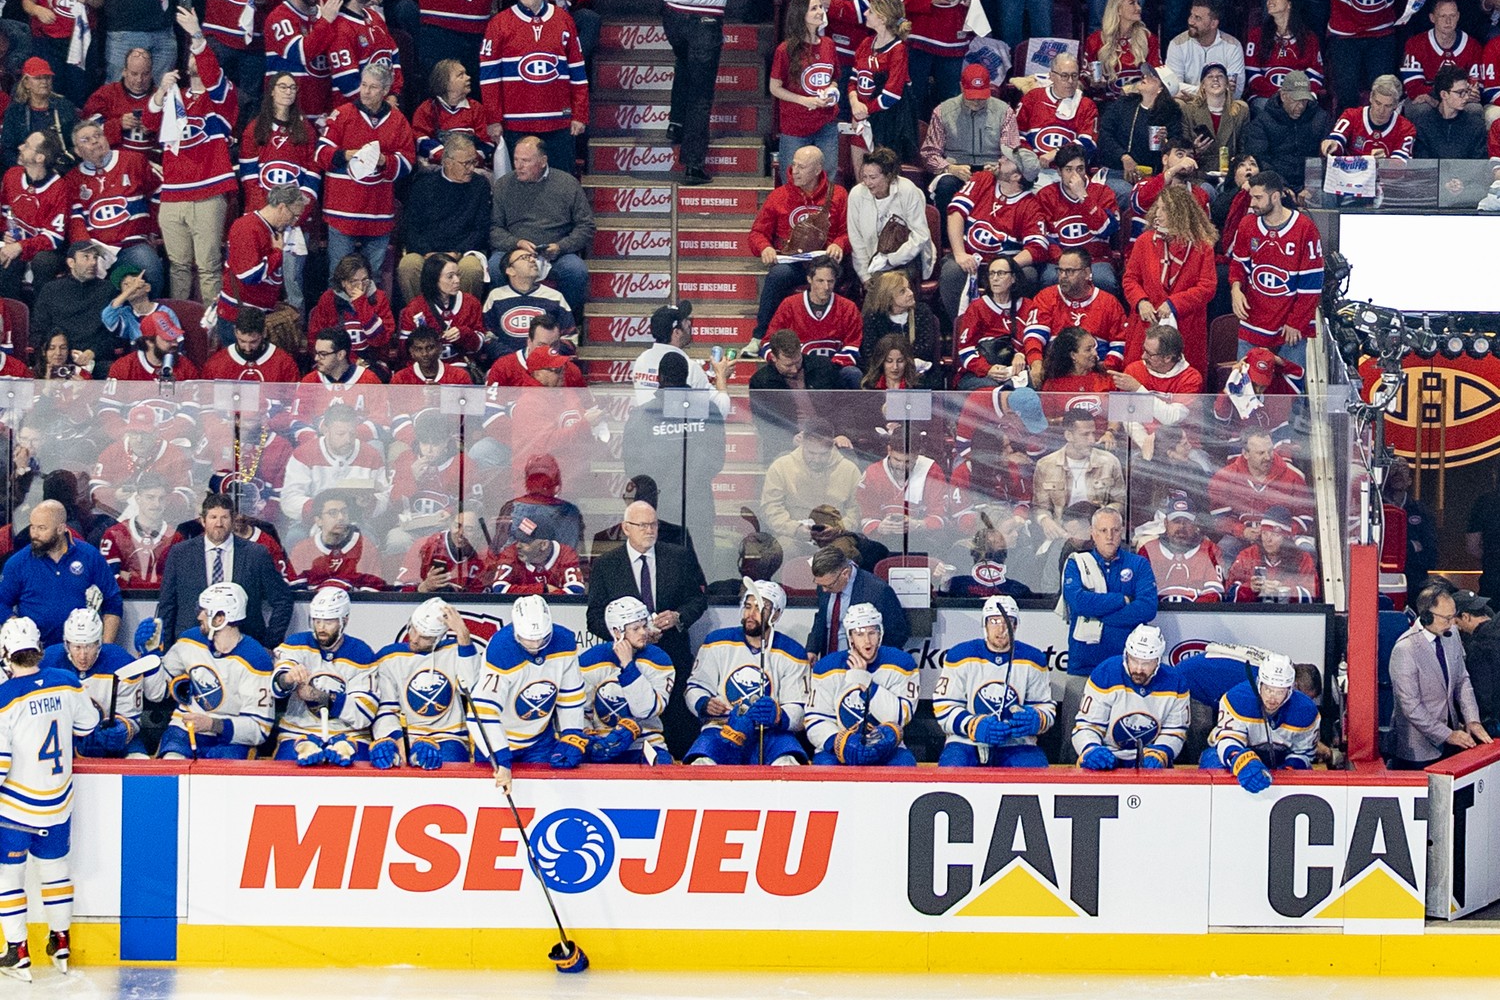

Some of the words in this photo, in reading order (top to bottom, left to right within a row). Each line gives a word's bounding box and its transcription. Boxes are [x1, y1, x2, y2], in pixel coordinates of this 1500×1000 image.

[271, 18, 294, 42] 20
[561, 31, 571, 46] C
[619, 25, 667, 48] Molso
[330, 49, 352, 68] 93
[1245, 42, 1255, 57] 8
[615, 105, 671, 129] Molso
[710, 115, 737, 123] SEMBLE
[614, 146, 677, 171] Molson
[705, 157, 737, 165] NSEMBLE
[681, 198, 699, 206] TOUS
[701, 198, 738, 206] ENSEMBLE
[51, 213, 66, 232] 4
[701, 241, 737, 249] ENSEMBLE
[1285, 242, 1296, 256] C
[679, 283, 698, 291] TOUS
[700, 283, 737, 291] ENSEMBLE
[1024, 307, 1039, 325] 21
[609, 317, 652, 341] Mols
[700, 327, 738, 335] ENSEMBLE
[653, 419, 706, 436] SÉCURITÉ
[712, 484, 736, 492] EMBLE
[485, 673, 500, 695] 71
[28, 697, 63, 716] BYRAM
[38, 719, 63, 776] 4
[907, 791, 1119, 917] CAT
